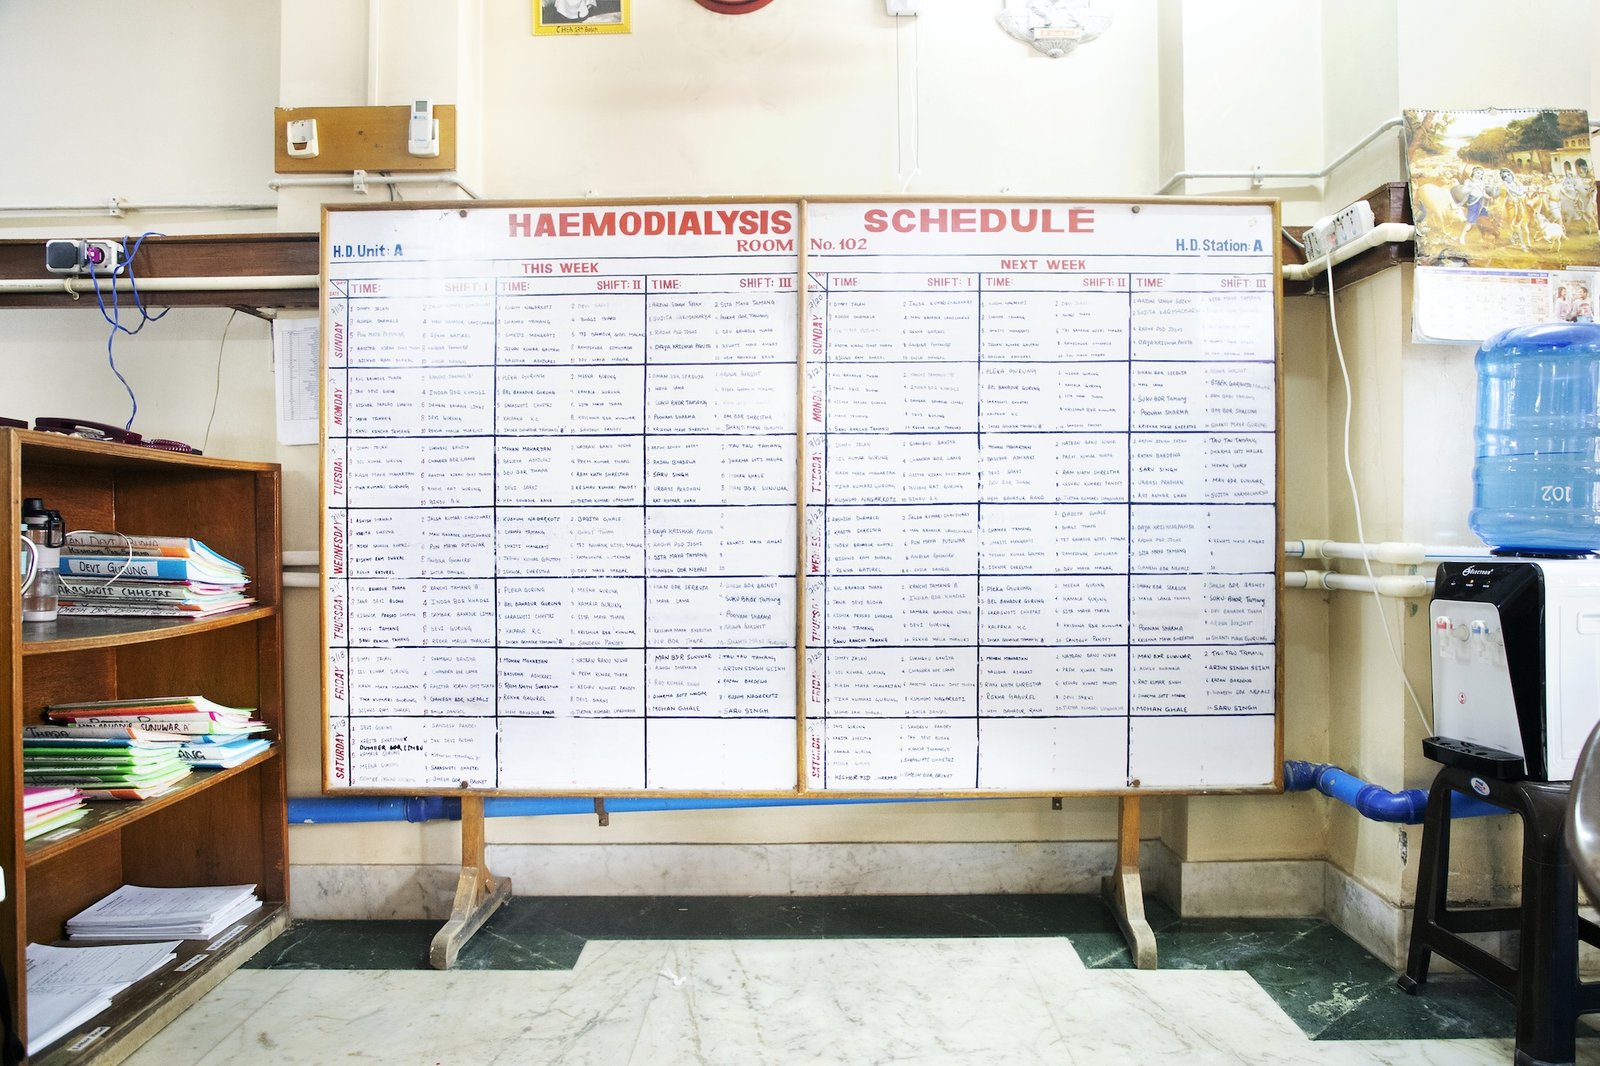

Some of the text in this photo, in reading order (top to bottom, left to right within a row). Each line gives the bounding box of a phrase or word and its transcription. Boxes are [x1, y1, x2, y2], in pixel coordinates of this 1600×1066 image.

[508, 208, 1095, 238] HAEMODIALYSIS SCHEDULE
[394, 243, 403, 256] A
[736, 239, 794, 252] ROOM
[810, 237, 867, 250] No. 102
[1253, 239, 1263, 252] A
[522, 262, 599, 275] THIS WEEK
[1000, 259, 1086, 271] NEXT WEEK
[501, 280, 531, 292] TIME:
[596, 279, 641, 292] SHIFT: II
[651, 279, 682, 290] TIME:
[739, 276, 792, 289] SHIFT: III
[927, 276, 972, 287] SHIFT: I
[986, 276, 1014, 287] TIME:
[1082, 277, 1125, 288] SHIFT: II
[1137, 277, 1165, 288] TIME:
[1220, 278, 1267, 288] SHIFT: III
[351, 283, 382, 294] TIME:
[335, 322, 344, 359] SUNDAY
[813, 314, 824, 355] SUNDAY
[334, 388, 344, 426] MONDAY
[1541, 485, 1572, 503] 102
[334, 518, 344, 576] WEDNESDAY
[79, 561, 101, 574] DEVI
[334, 594, 344, 640] THURSDAY
[335, 665, 345, 701] FRIDAY
[335, 732, 345, 779] SATURDAY
